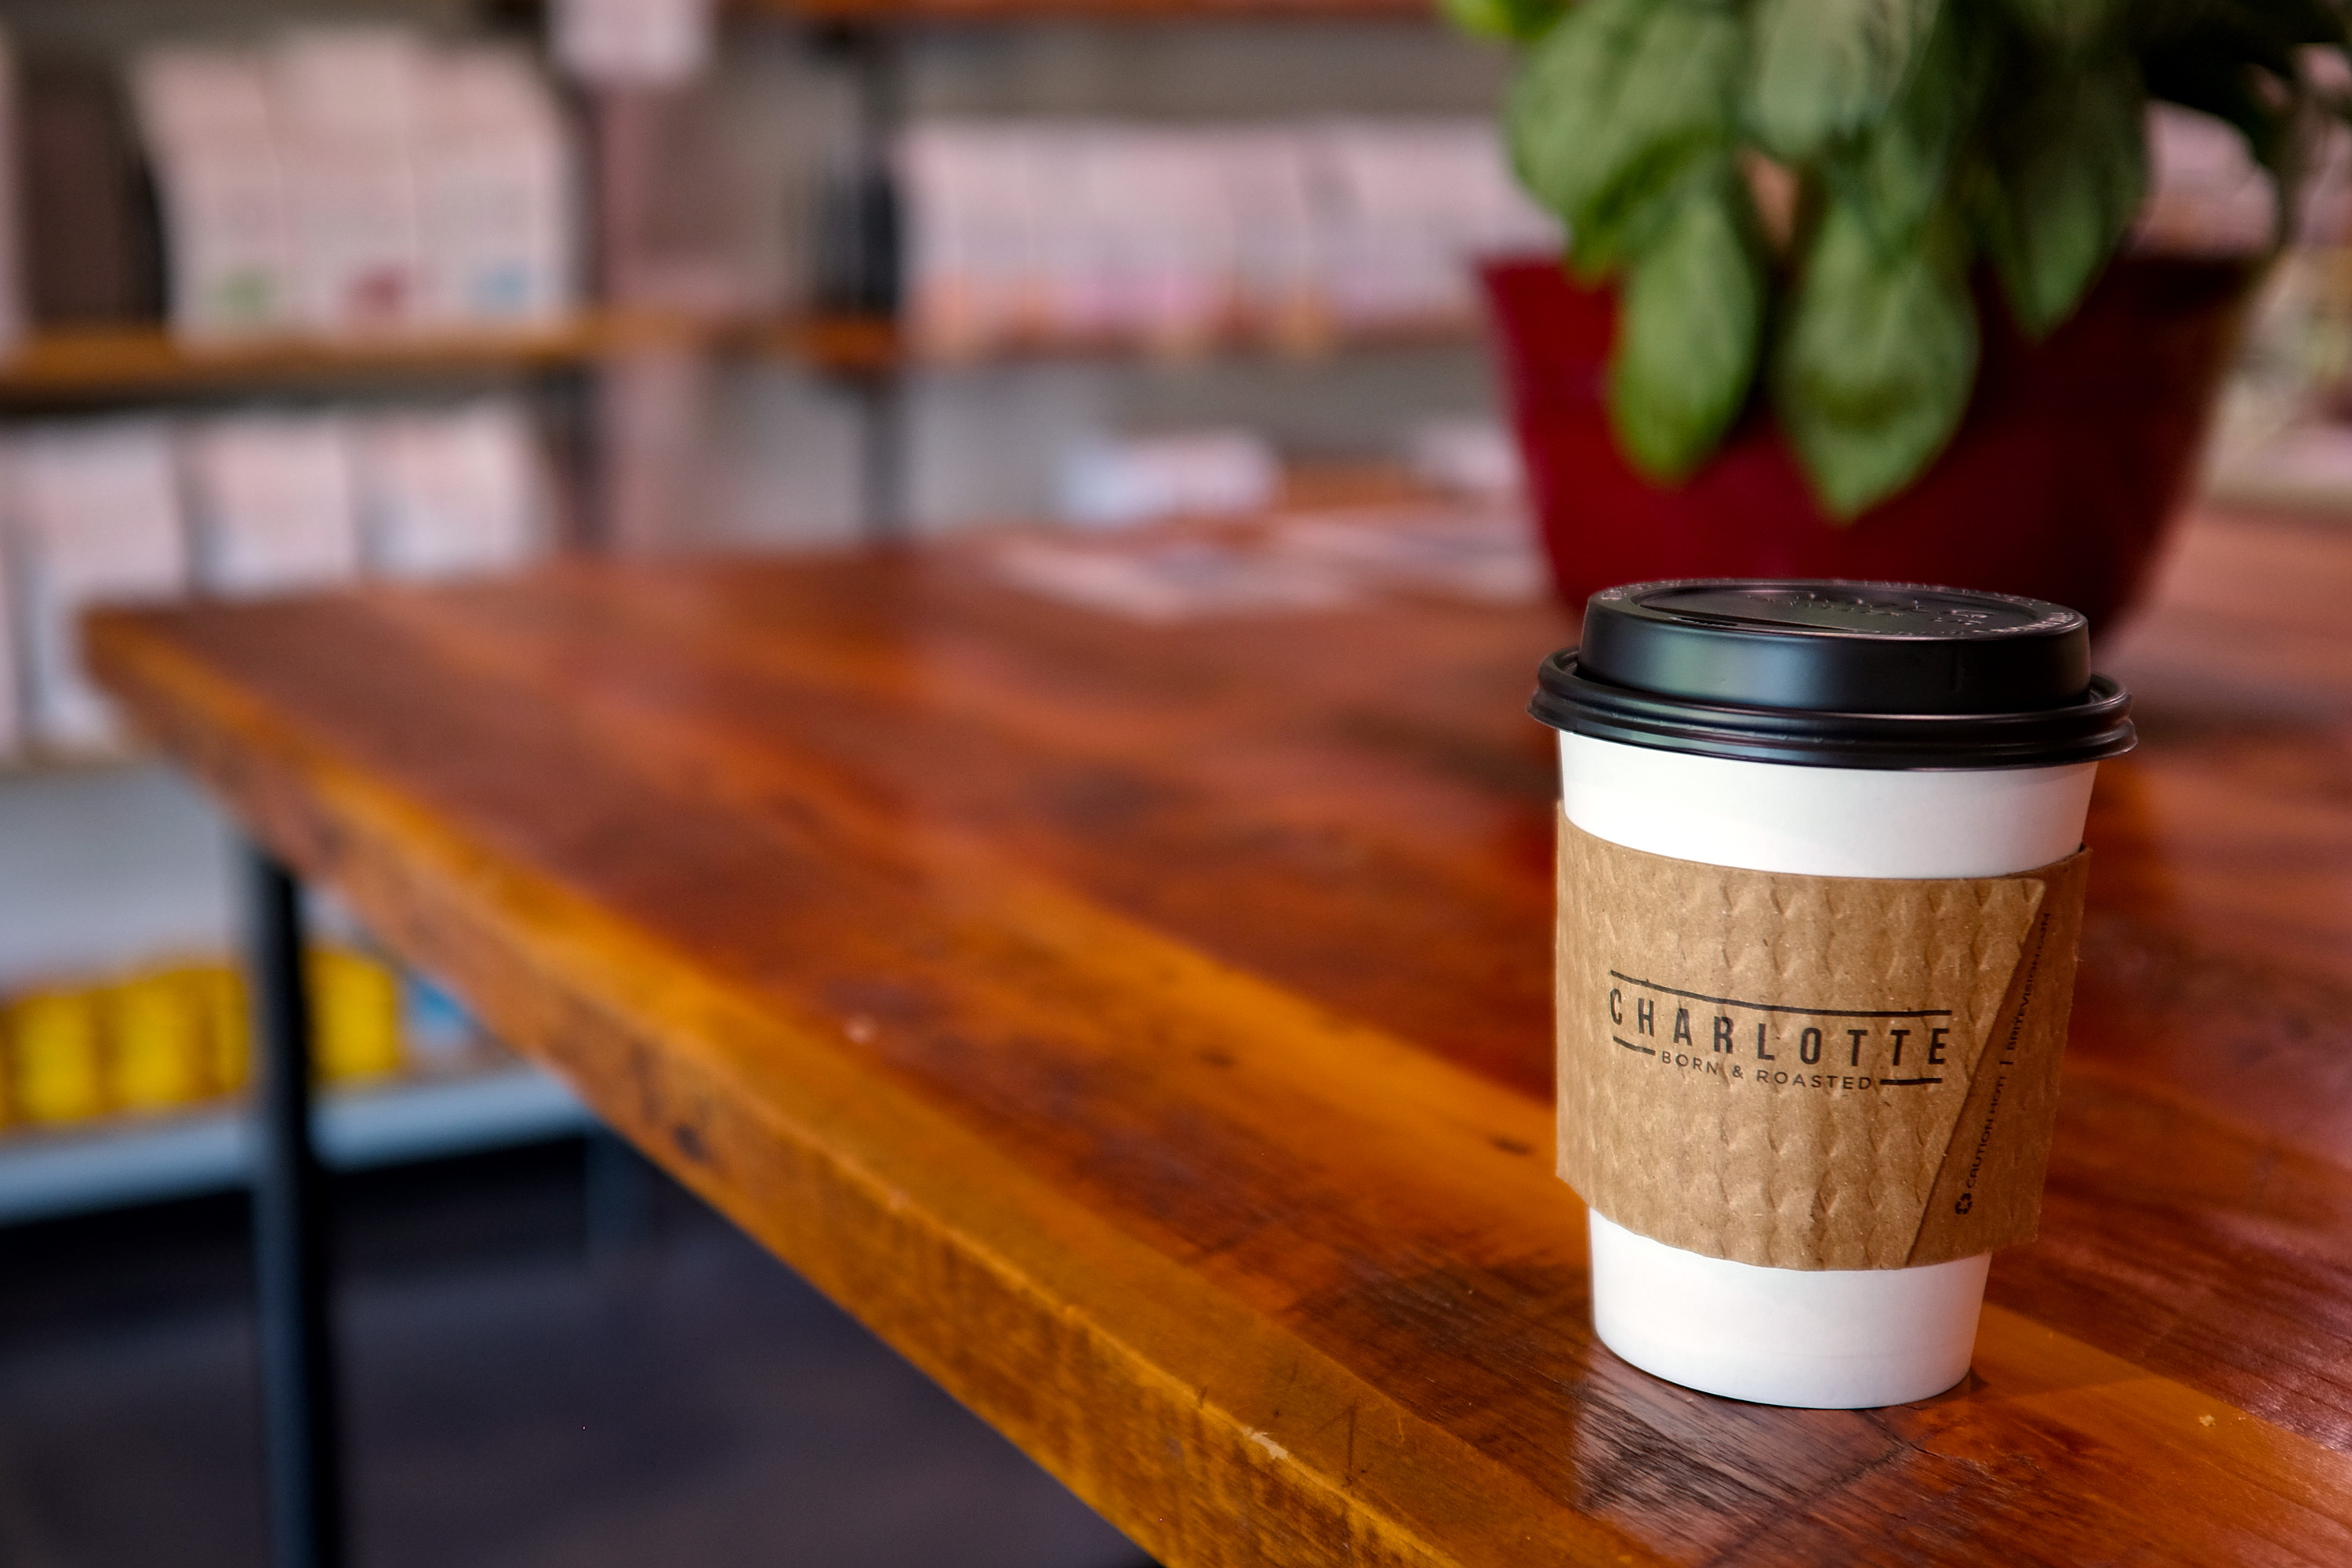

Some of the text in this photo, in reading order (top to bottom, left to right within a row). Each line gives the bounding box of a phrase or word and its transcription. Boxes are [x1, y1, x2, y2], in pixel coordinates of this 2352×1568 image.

[1610, 988, 1950, 1067] CHARLOTTE
[1661, 1051, 1872, 1090] BORN & ROASTED
[1966, 1119, 1993, 1189] CAUTION
